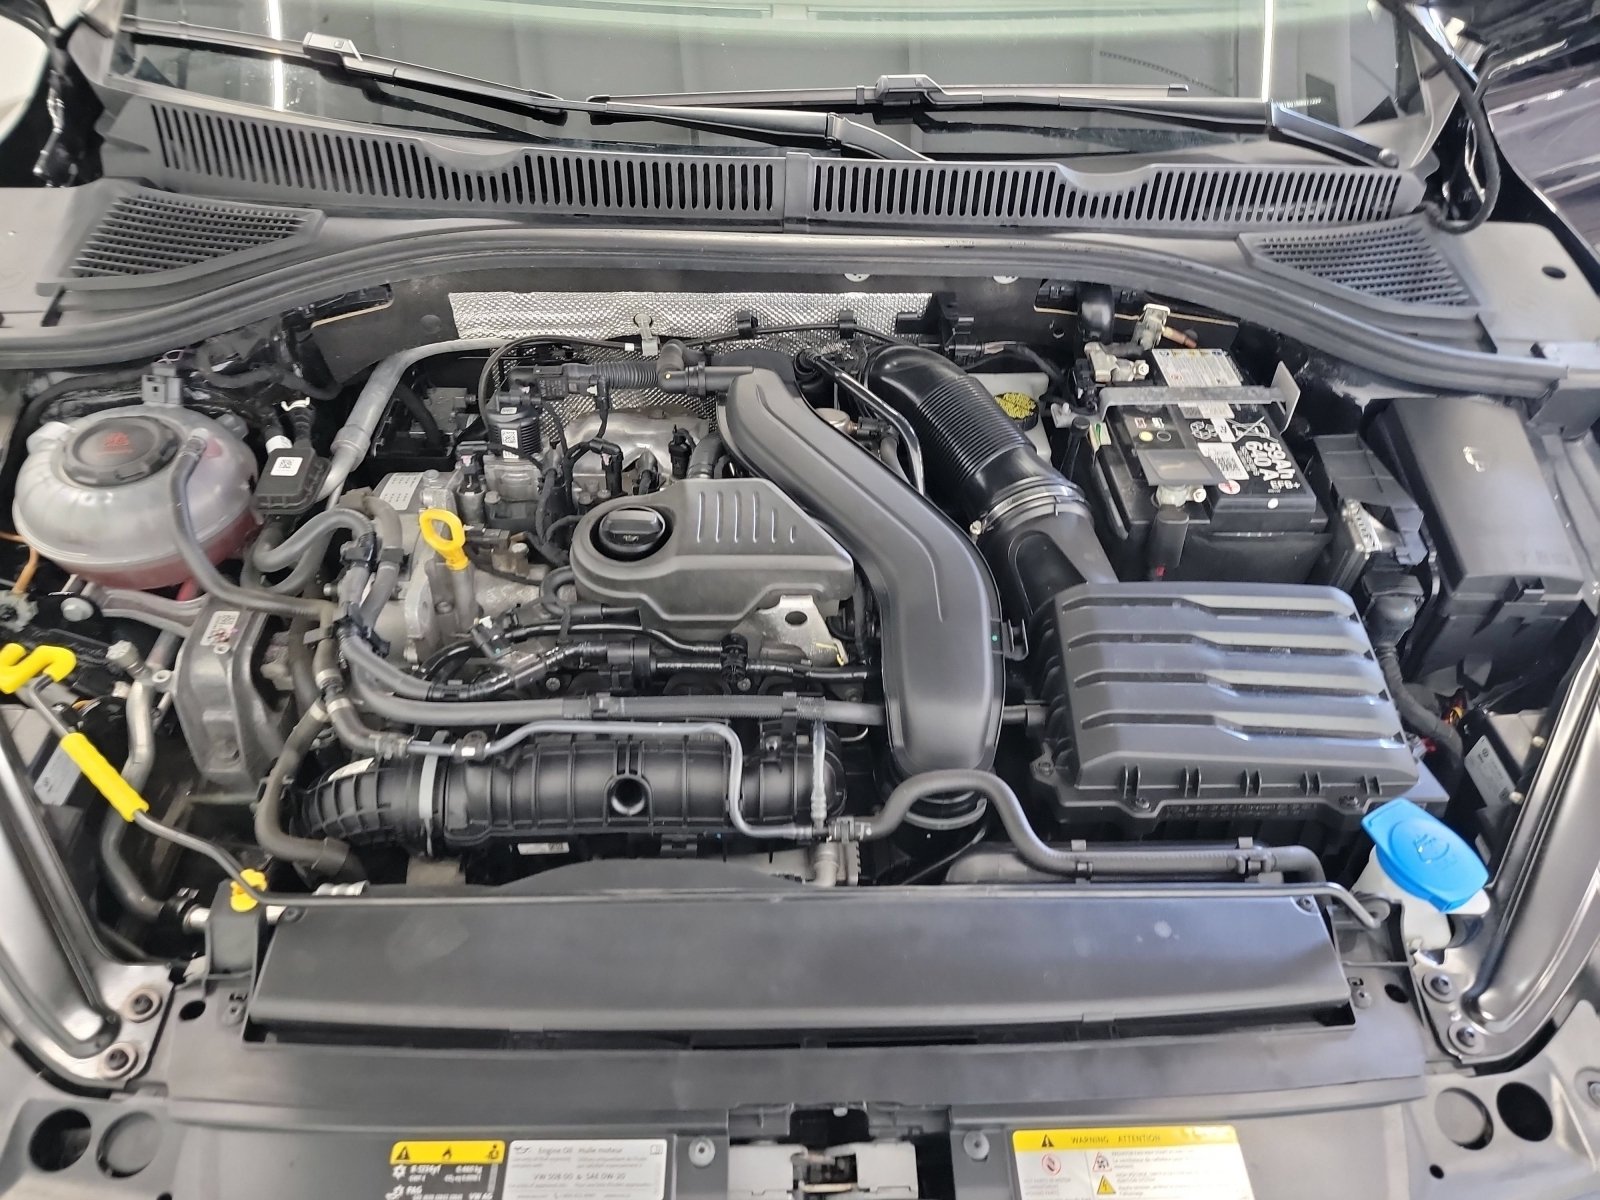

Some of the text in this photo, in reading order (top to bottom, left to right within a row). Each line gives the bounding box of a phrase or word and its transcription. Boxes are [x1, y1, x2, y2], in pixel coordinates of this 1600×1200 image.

[1245, 441, 1272, 467] 640
[1259, 468, 1280, 481] A
[1264, 442, 1296, 479] 59Ah
[1071, 1134, 1161, 1144] WARNING ATTENTION
[538, 1147, 561, 1155] Engine
